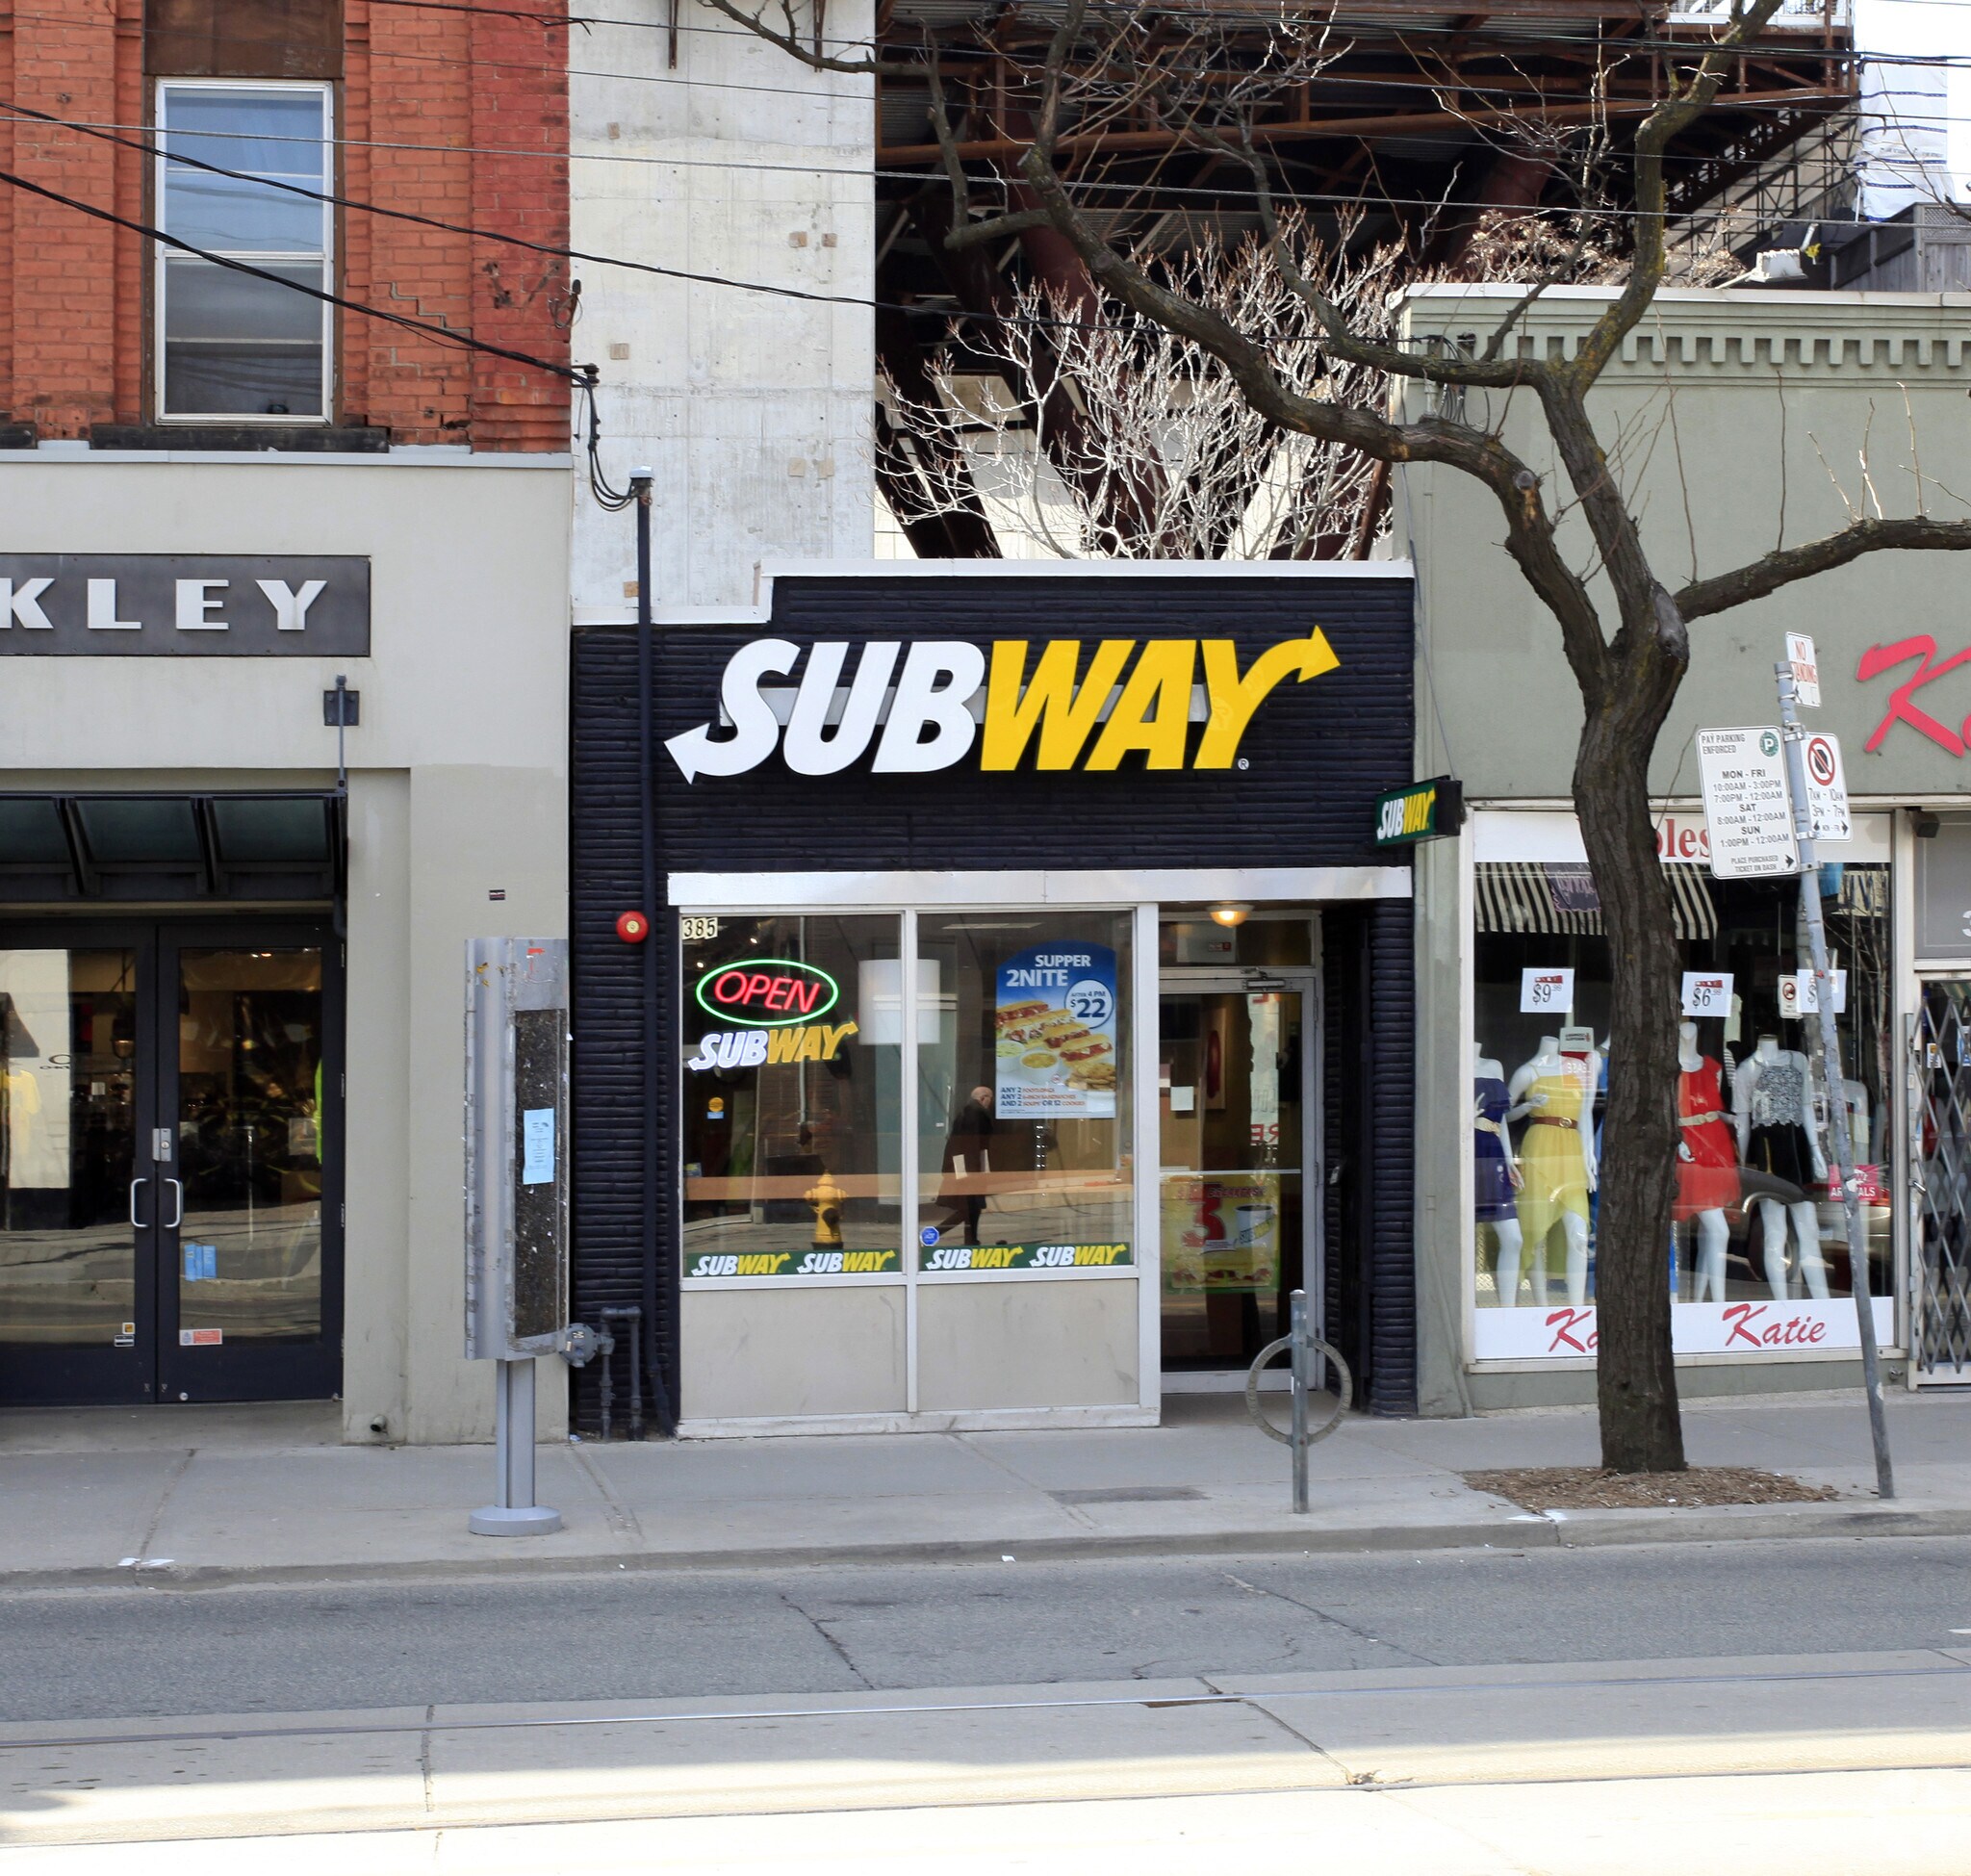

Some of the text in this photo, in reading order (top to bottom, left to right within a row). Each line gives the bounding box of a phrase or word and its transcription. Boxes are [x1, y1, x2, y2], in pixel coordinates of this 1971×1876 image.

[0, 578, 327, 630] KLEY
[1795, 640, 1806, 660] NO
[664, 626, 1341, 784] SUBWAY
[1702, 733, 1746, 744] PAY PARKING
[1702, 744, 1737, 755] ENFORCED
[1722, 770, 1743, 779] MON
[1751, 769, 1766, 778] FRI
[1713, 781, 1746, 791] 10:00AM
[1753, 780, 1781, 789] 3:00PM
[1714, 793, 1743, 803] 7:00PM
[1751, 791, 1783, 801] 12:00AM
[1376, 787, 1436, 841] SUBWAY
[1739, 803, 1756, 812] SAT
[1717, 815, 1746, 825] 8:00AM
[1753, 812, 1786, 822] 12:00AM
[1741, 826, 1760, 835] SUN
[1721, 837, 1749, 847] 1:00PM
[1756, 834, 1790, 844] 12:00AM
[1749, 855, 1779, 863] PURCHASED
[683, 918, 715, 938] 385
[1035, 955, 1091, 967] SUPPER
[1006, 969, 1068, 987] 2NITE
[714, 971, 821, 1014] OPEN
[688, 1020, 858, 1070] SUBWAY
[1830, 1187, 1876, 1197] ARALS
[691, 1250, 896, 1276] SUBWAY SUBWAY
[925, 1244, 1127, 1270] SUBWAY SUBWAY
[1722, 1303, 1827, 1348] Katie
